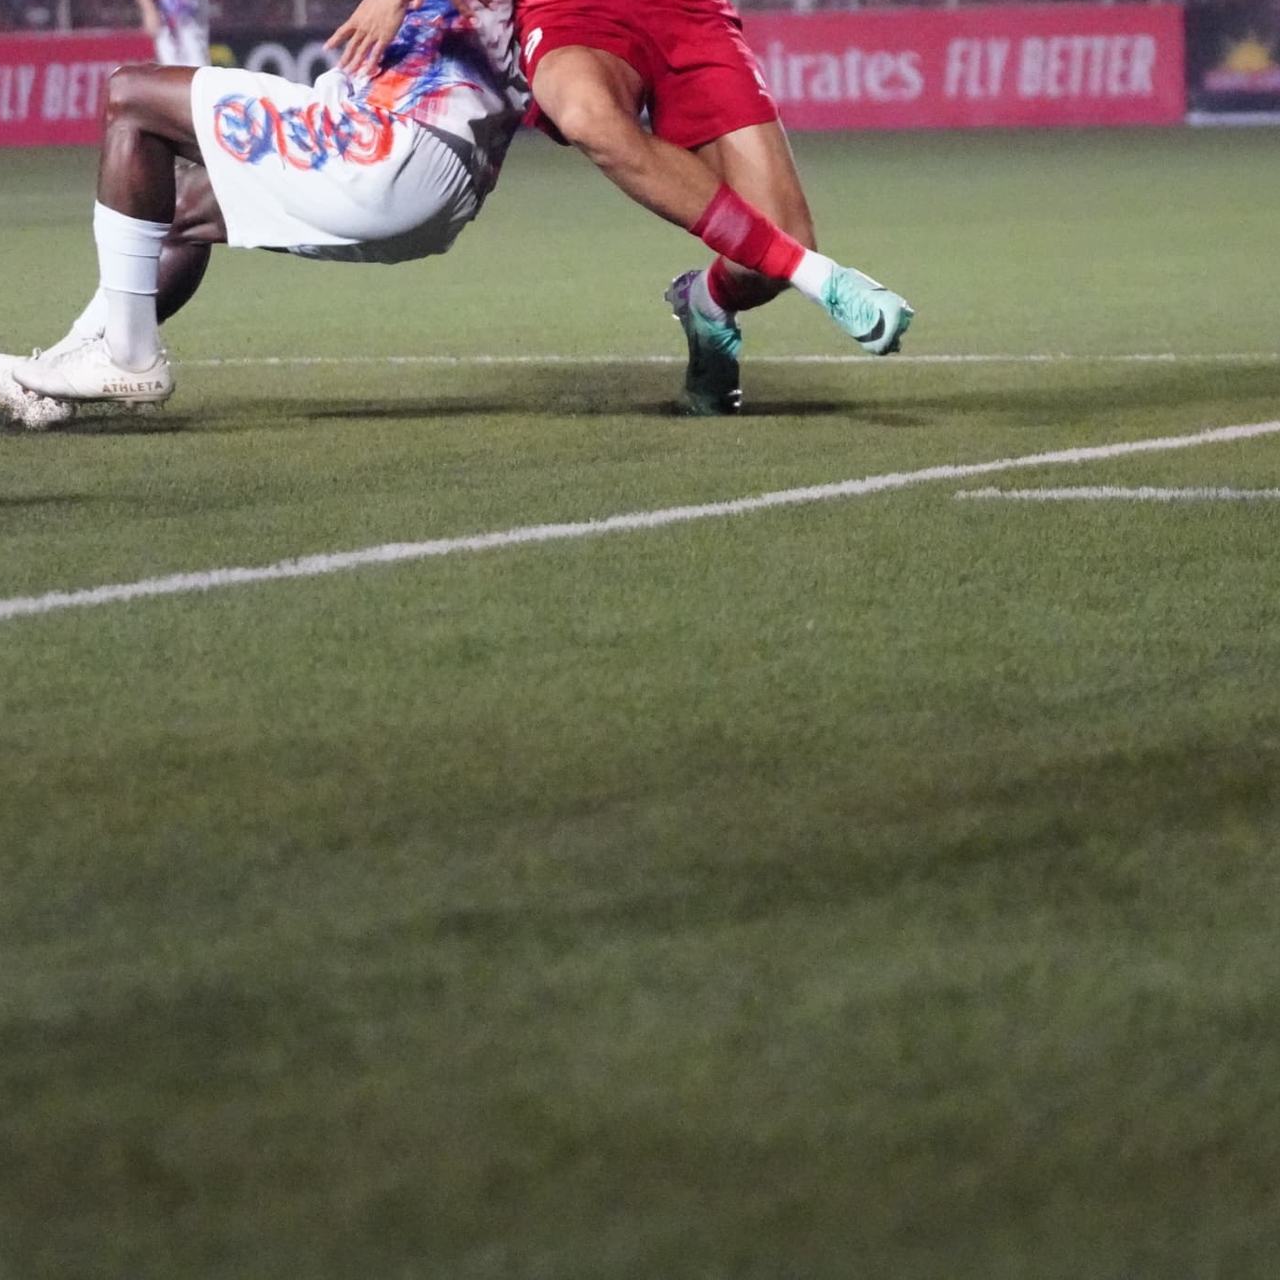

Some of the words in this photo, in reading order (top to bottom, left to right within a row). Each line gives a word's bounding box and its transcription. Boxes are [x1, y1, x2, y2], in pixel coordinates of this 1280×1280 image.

[757, 41, 924, 102] irates
[943, 38, 1008, 98] FLY
[1017, 34, 1157, 98] BETTER
[101, 380, 164, 394] ATHLETA
